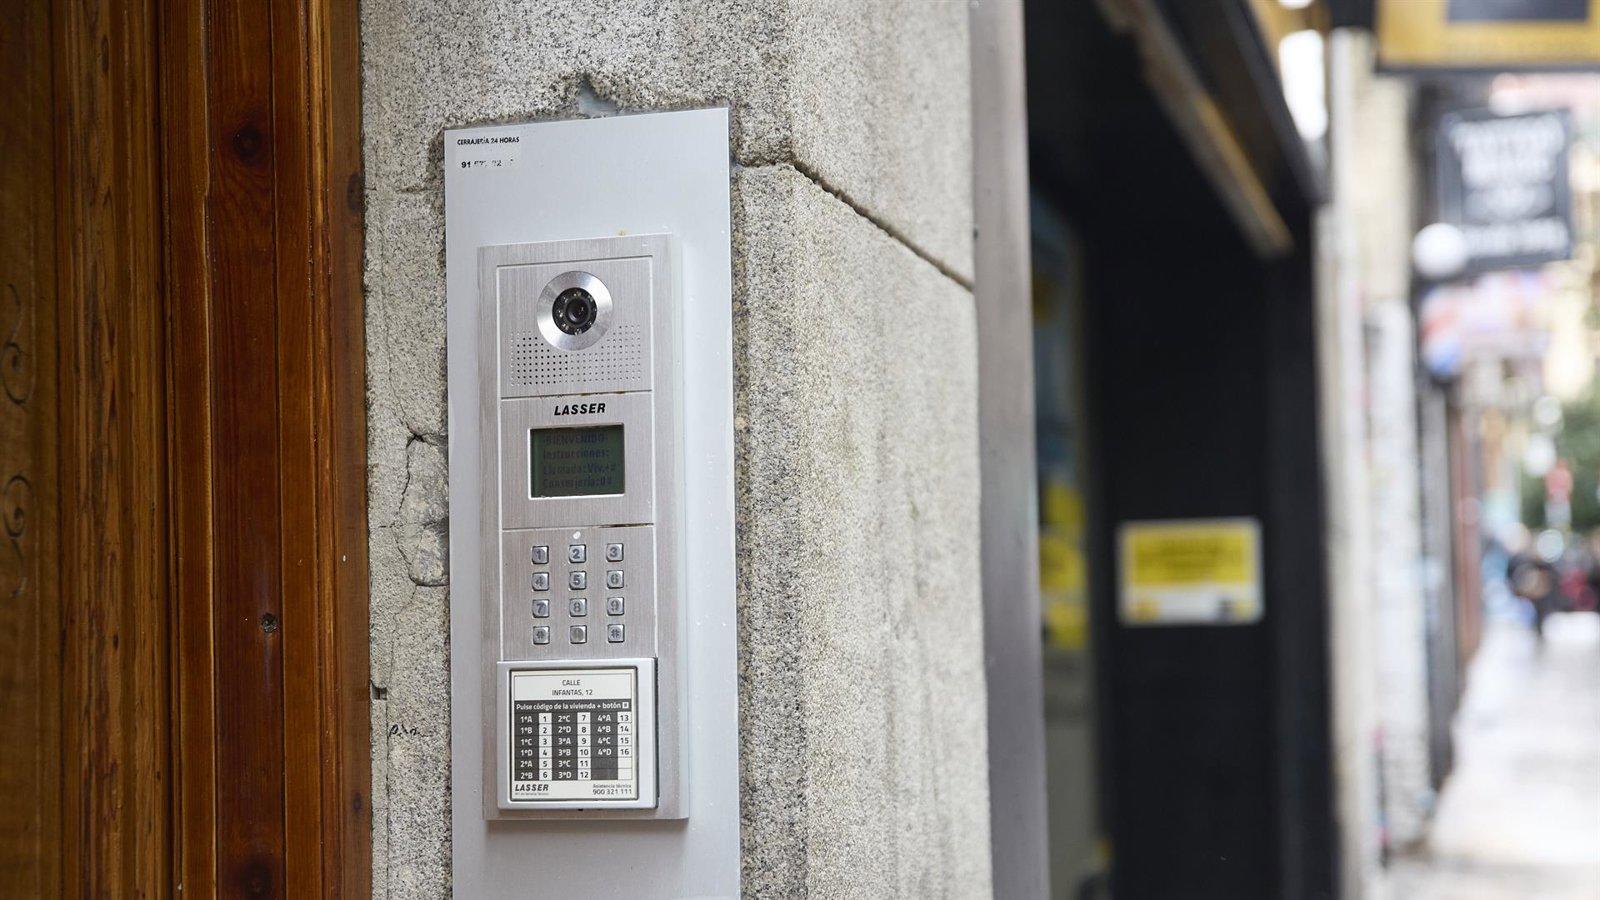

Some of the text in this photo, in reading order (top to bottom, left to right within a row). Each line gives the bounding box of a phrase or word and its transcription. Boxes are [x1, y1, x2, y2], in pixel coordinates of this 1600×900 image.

[554, 403, 606, 416] LASSER
[572, 548, 580, 559] 2
[610, 547, 618, 558] 3
[573, 575, 580, 585] 5
[611, 573, 618, 584] 6
[573, 602, 581, 612] 8
[610, 600, 619, 611] 9
